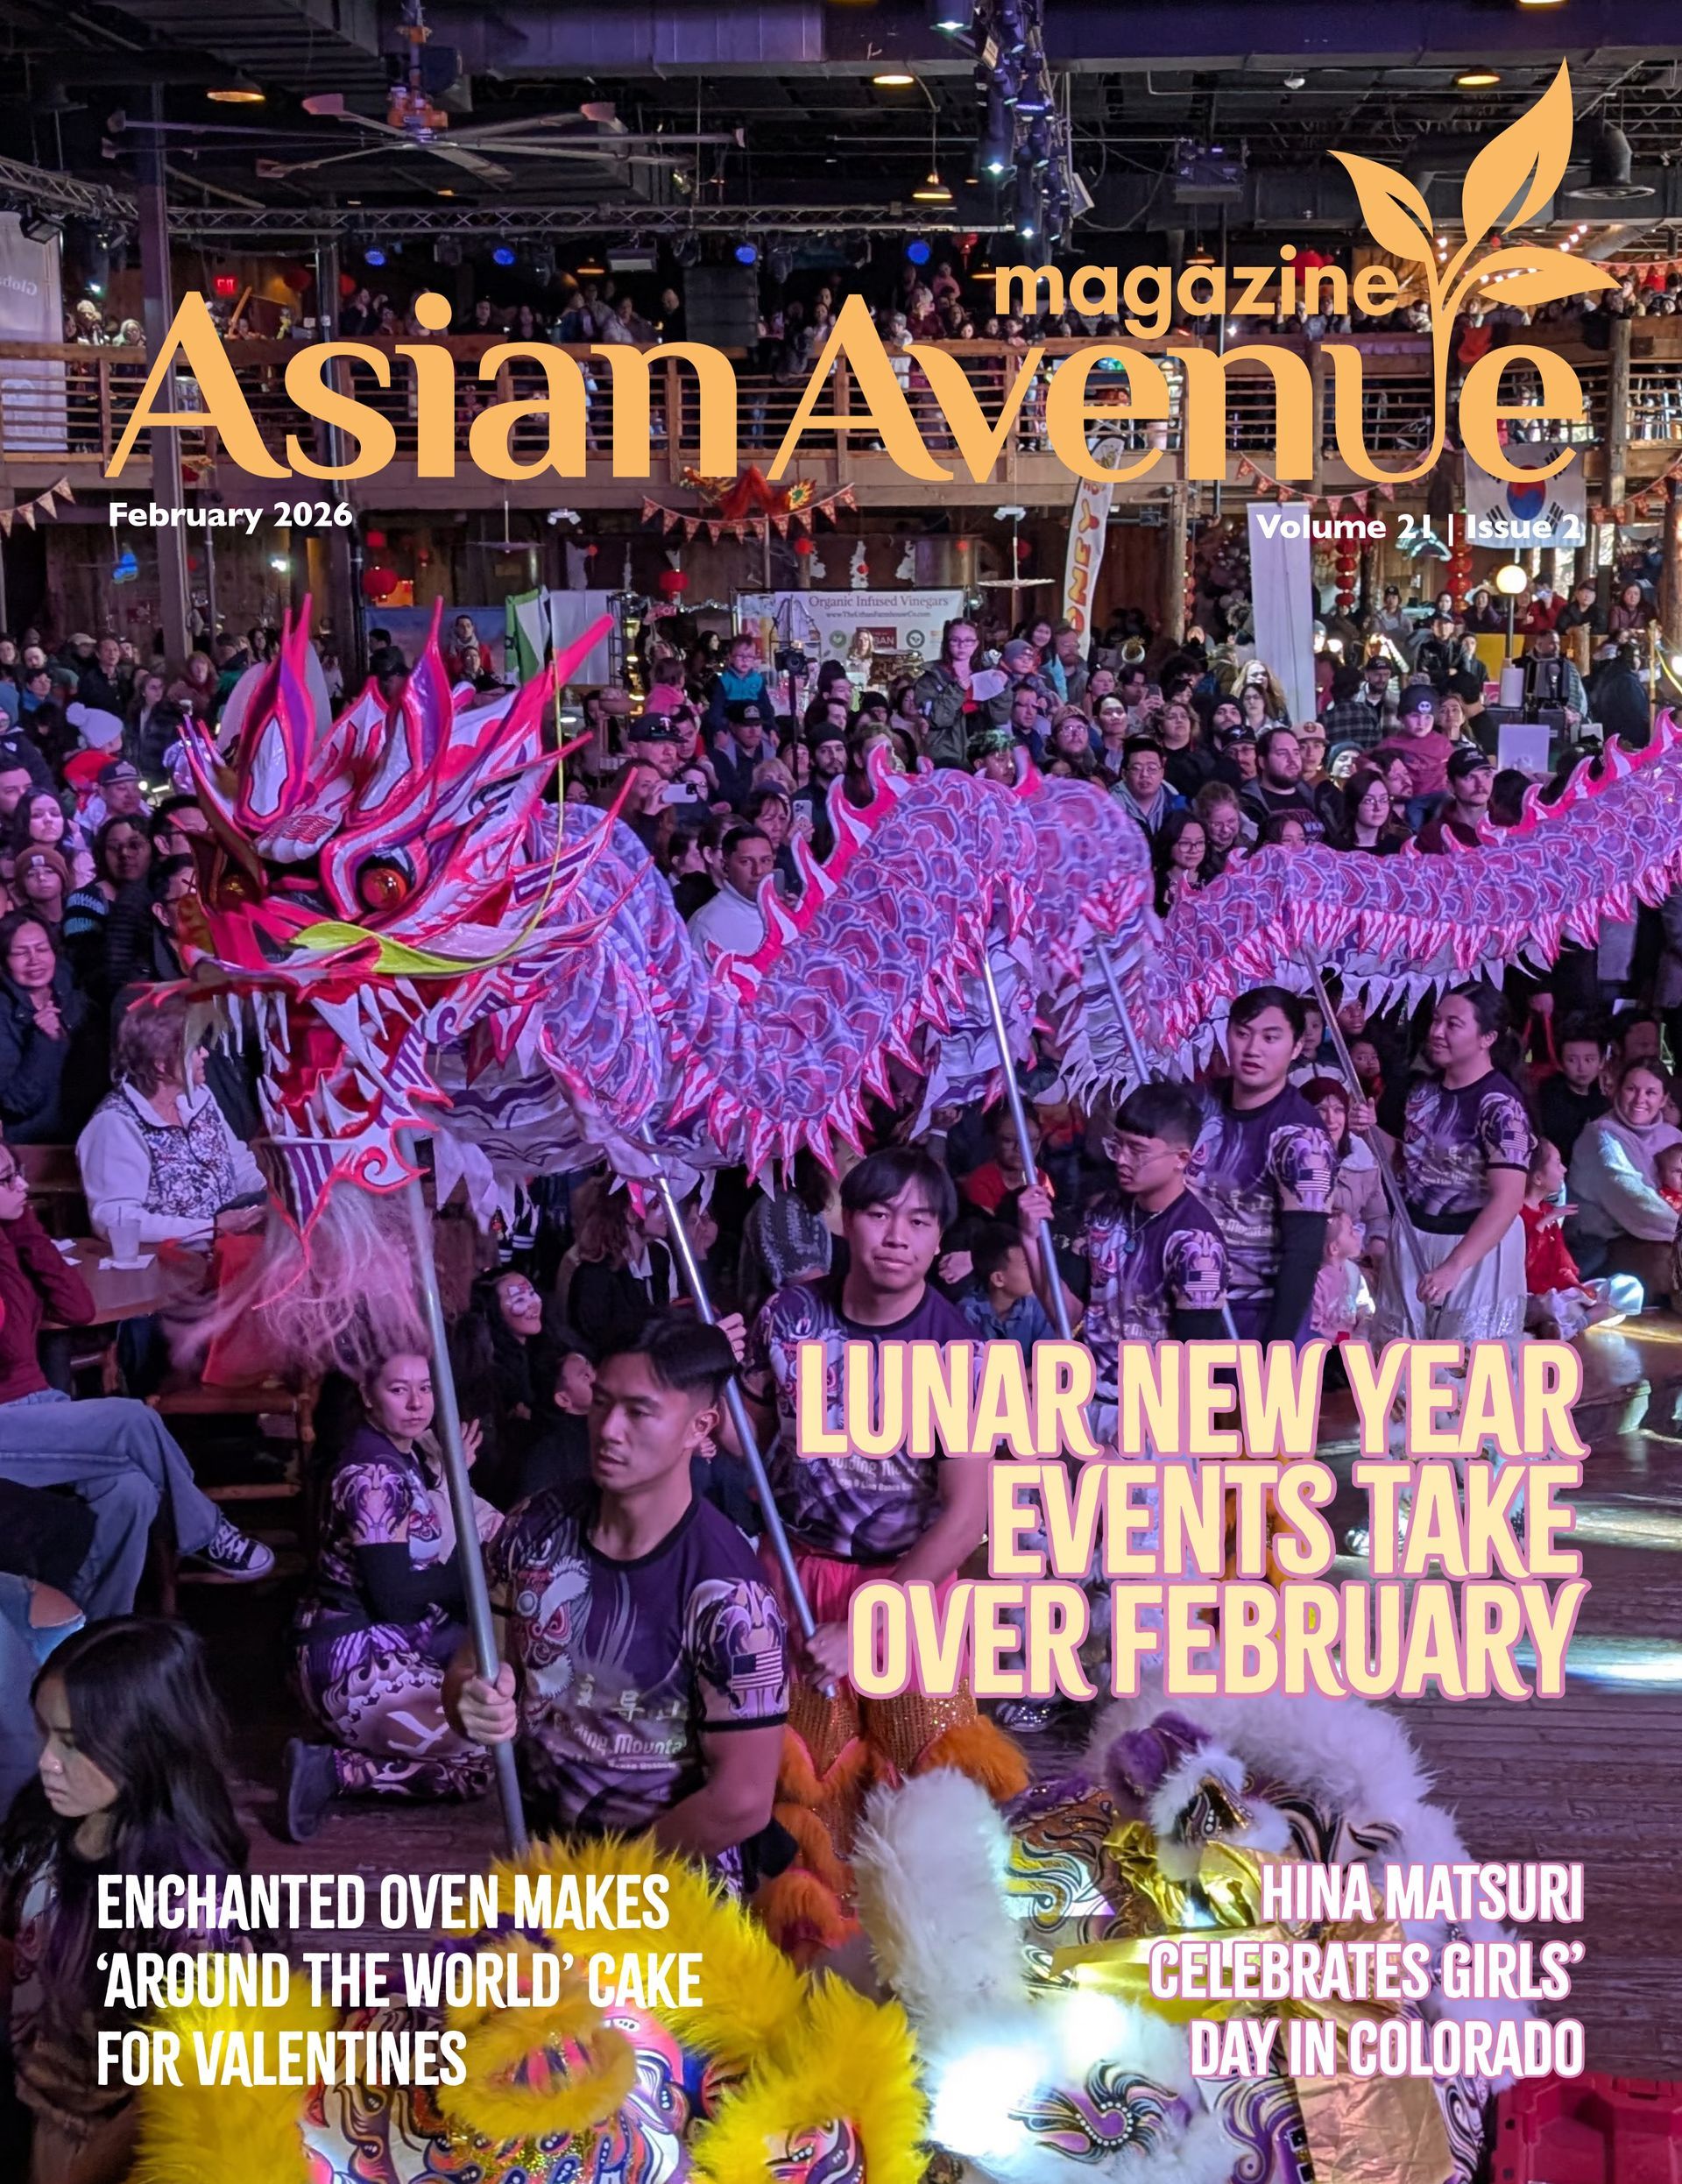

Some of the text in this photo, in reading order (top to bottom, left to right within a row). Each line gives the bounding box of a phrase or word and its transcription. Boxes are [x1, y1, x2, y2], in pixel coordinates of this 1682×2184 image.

[809, 596, 949, 609] Organic Infused Vinegars
[1066, 498, 1100, 637] ONEY
